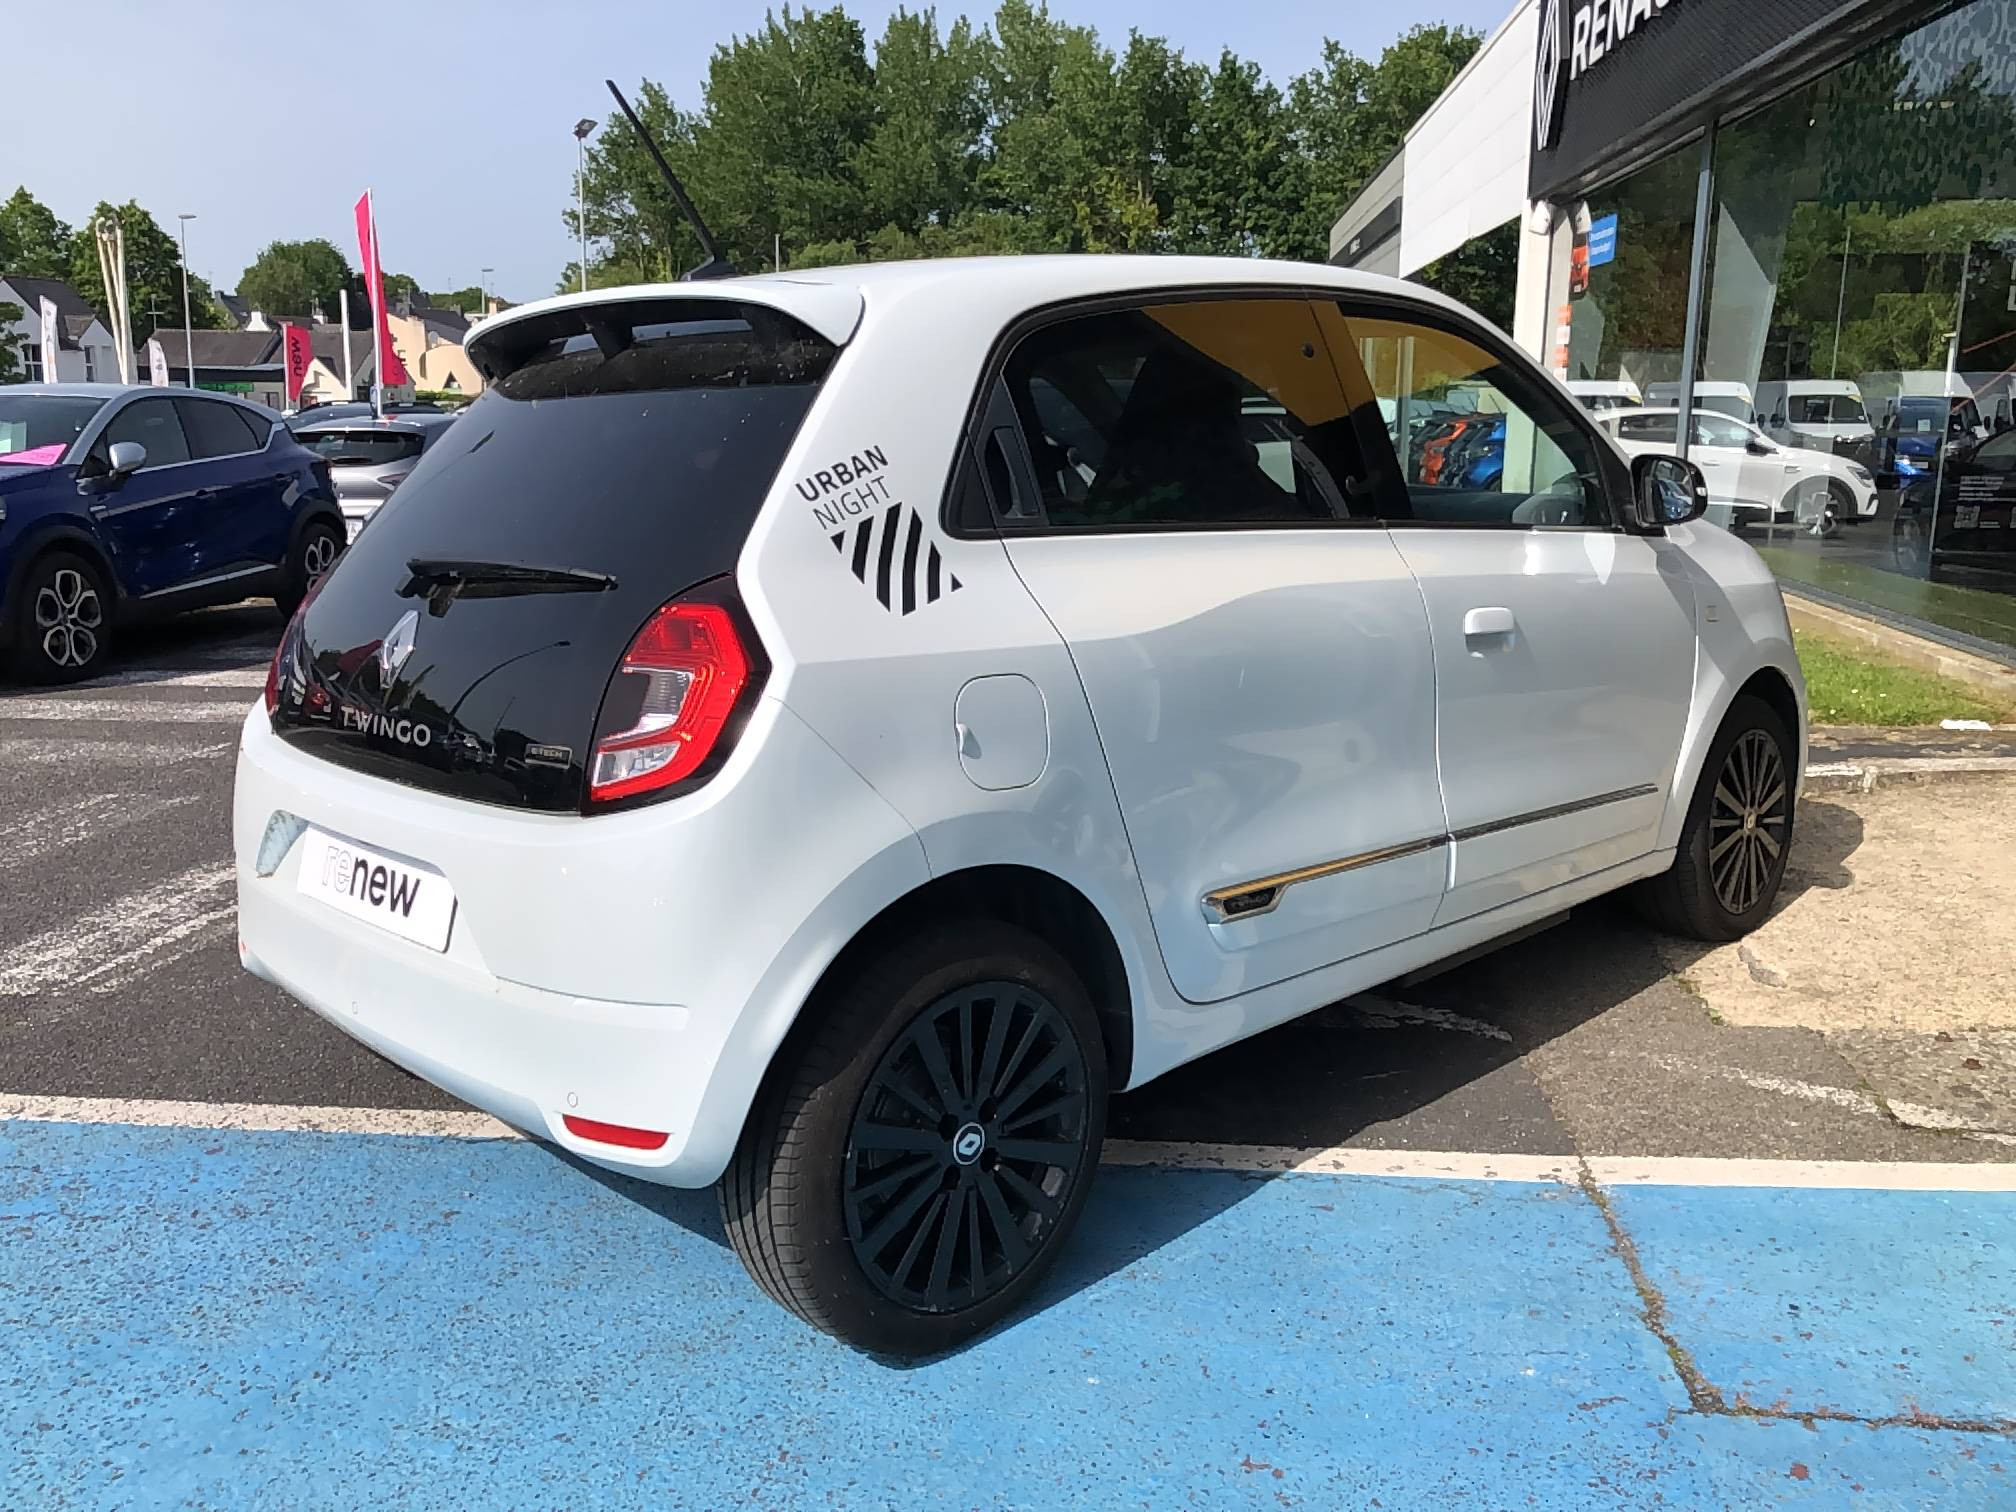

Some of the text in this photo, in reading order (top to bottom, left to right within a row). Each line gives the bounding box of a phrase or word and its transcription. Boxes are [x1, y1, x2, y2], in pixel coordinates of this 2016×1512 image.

[795, 445, 889, 502] URBAN
[812, 475, 891, 530] NIGHT
[341, 706, 431, 746] TWINGO
[322, 846, 421, 918] renew
